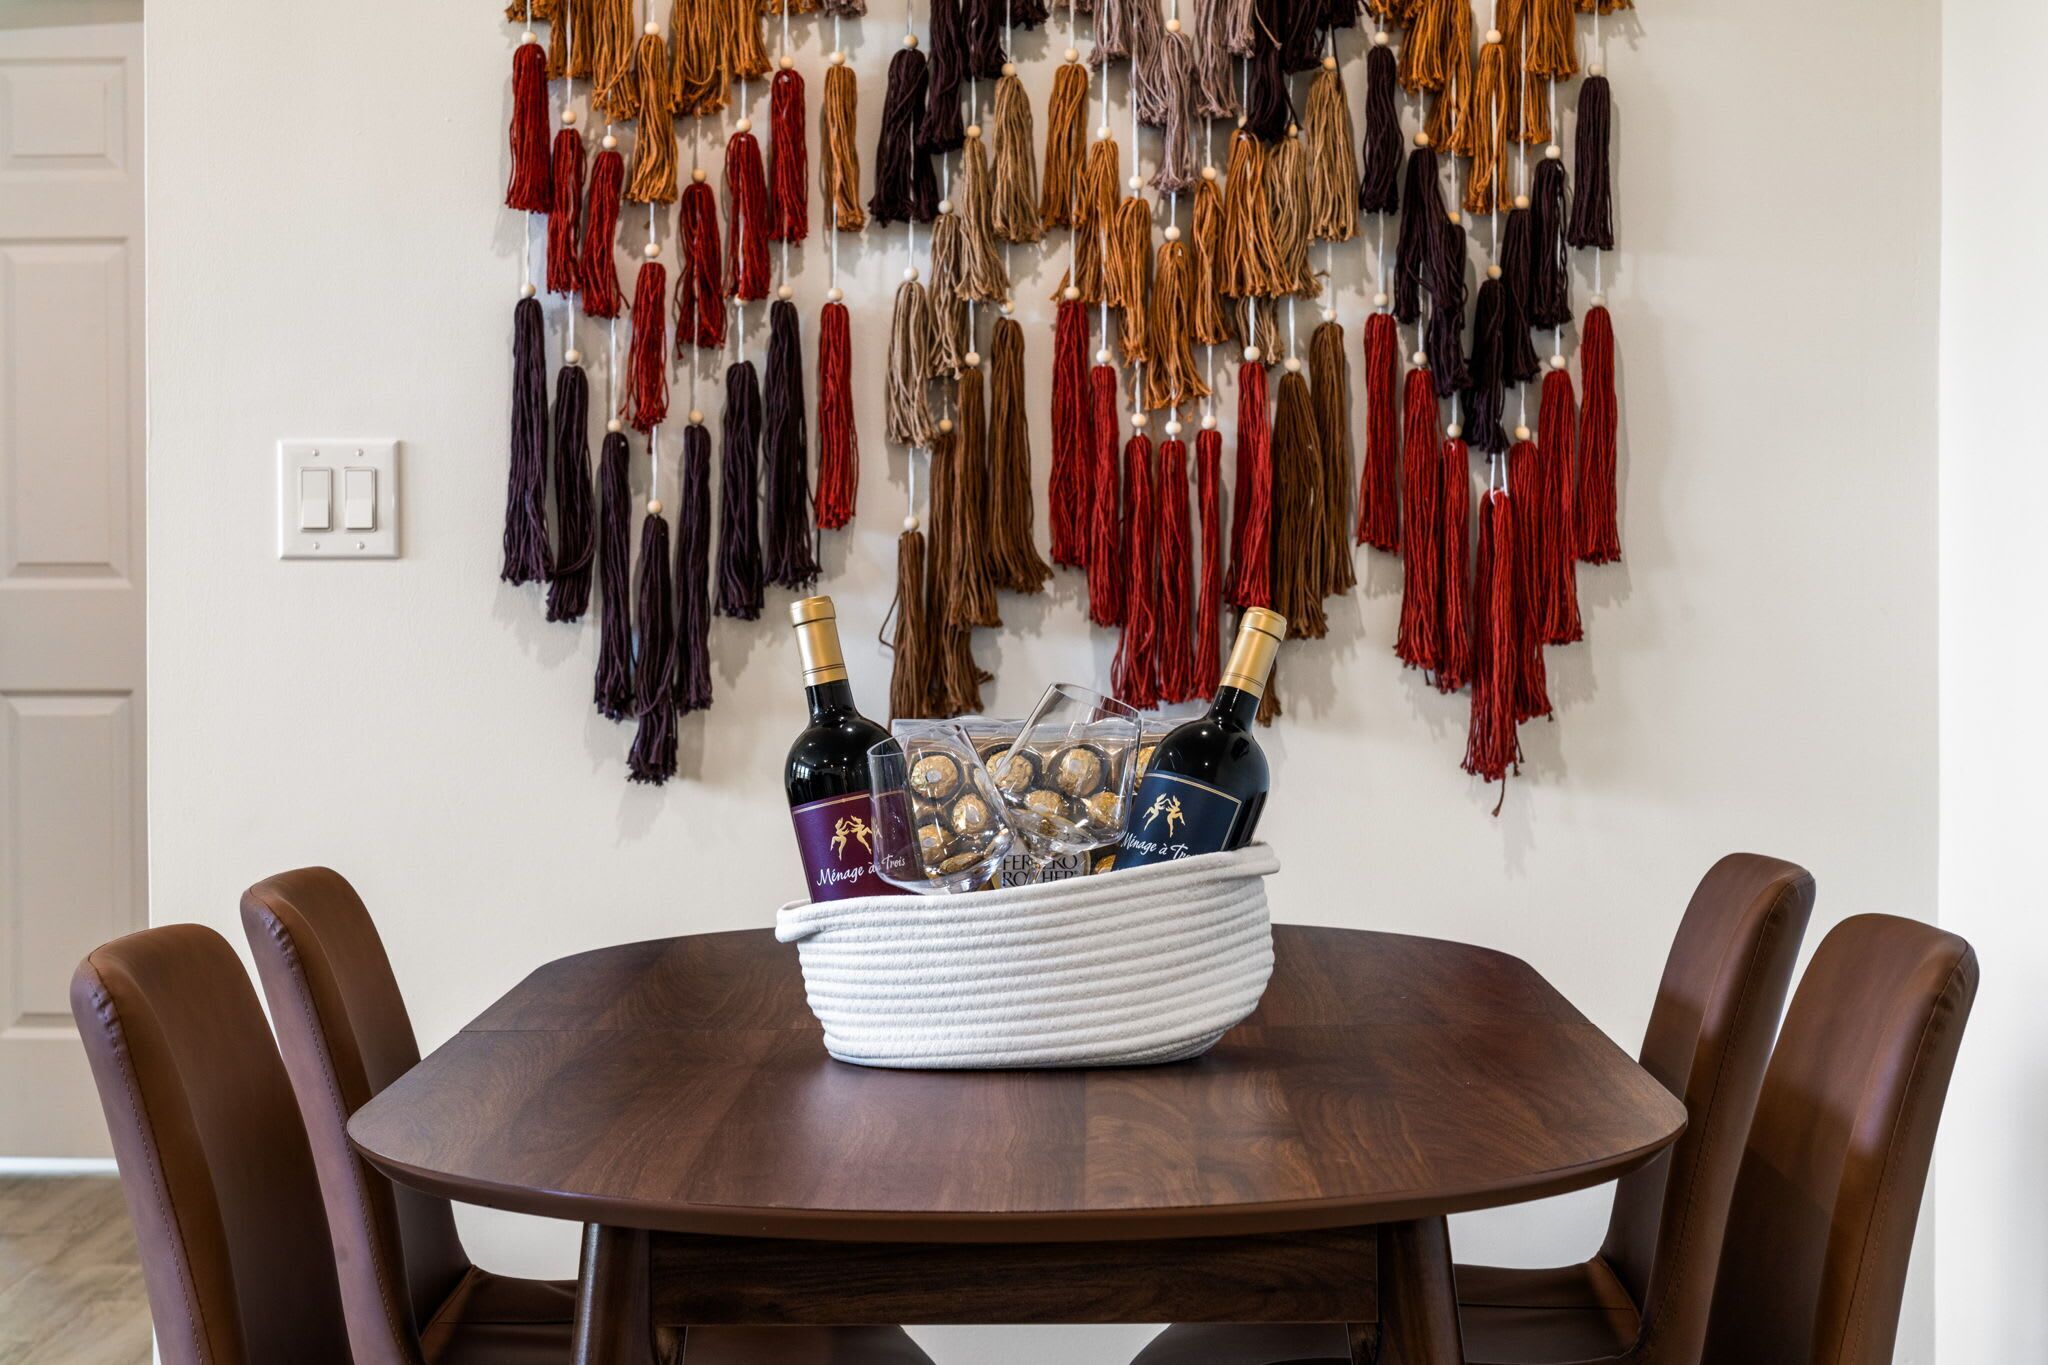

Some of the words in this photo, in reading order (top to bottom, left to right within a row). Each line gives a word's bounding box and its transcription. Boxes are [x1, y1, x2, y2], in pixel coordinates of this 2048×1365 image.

[1120, 832, 1157, 855] Ménage
[1158, 843, 1168, 855] à
[816, 866, 865, 887] Ménage
[868, 861, 878, 874] à
[881, 853, 906, 870] Trois
[1003, 871, 1074, 887] ROHER
